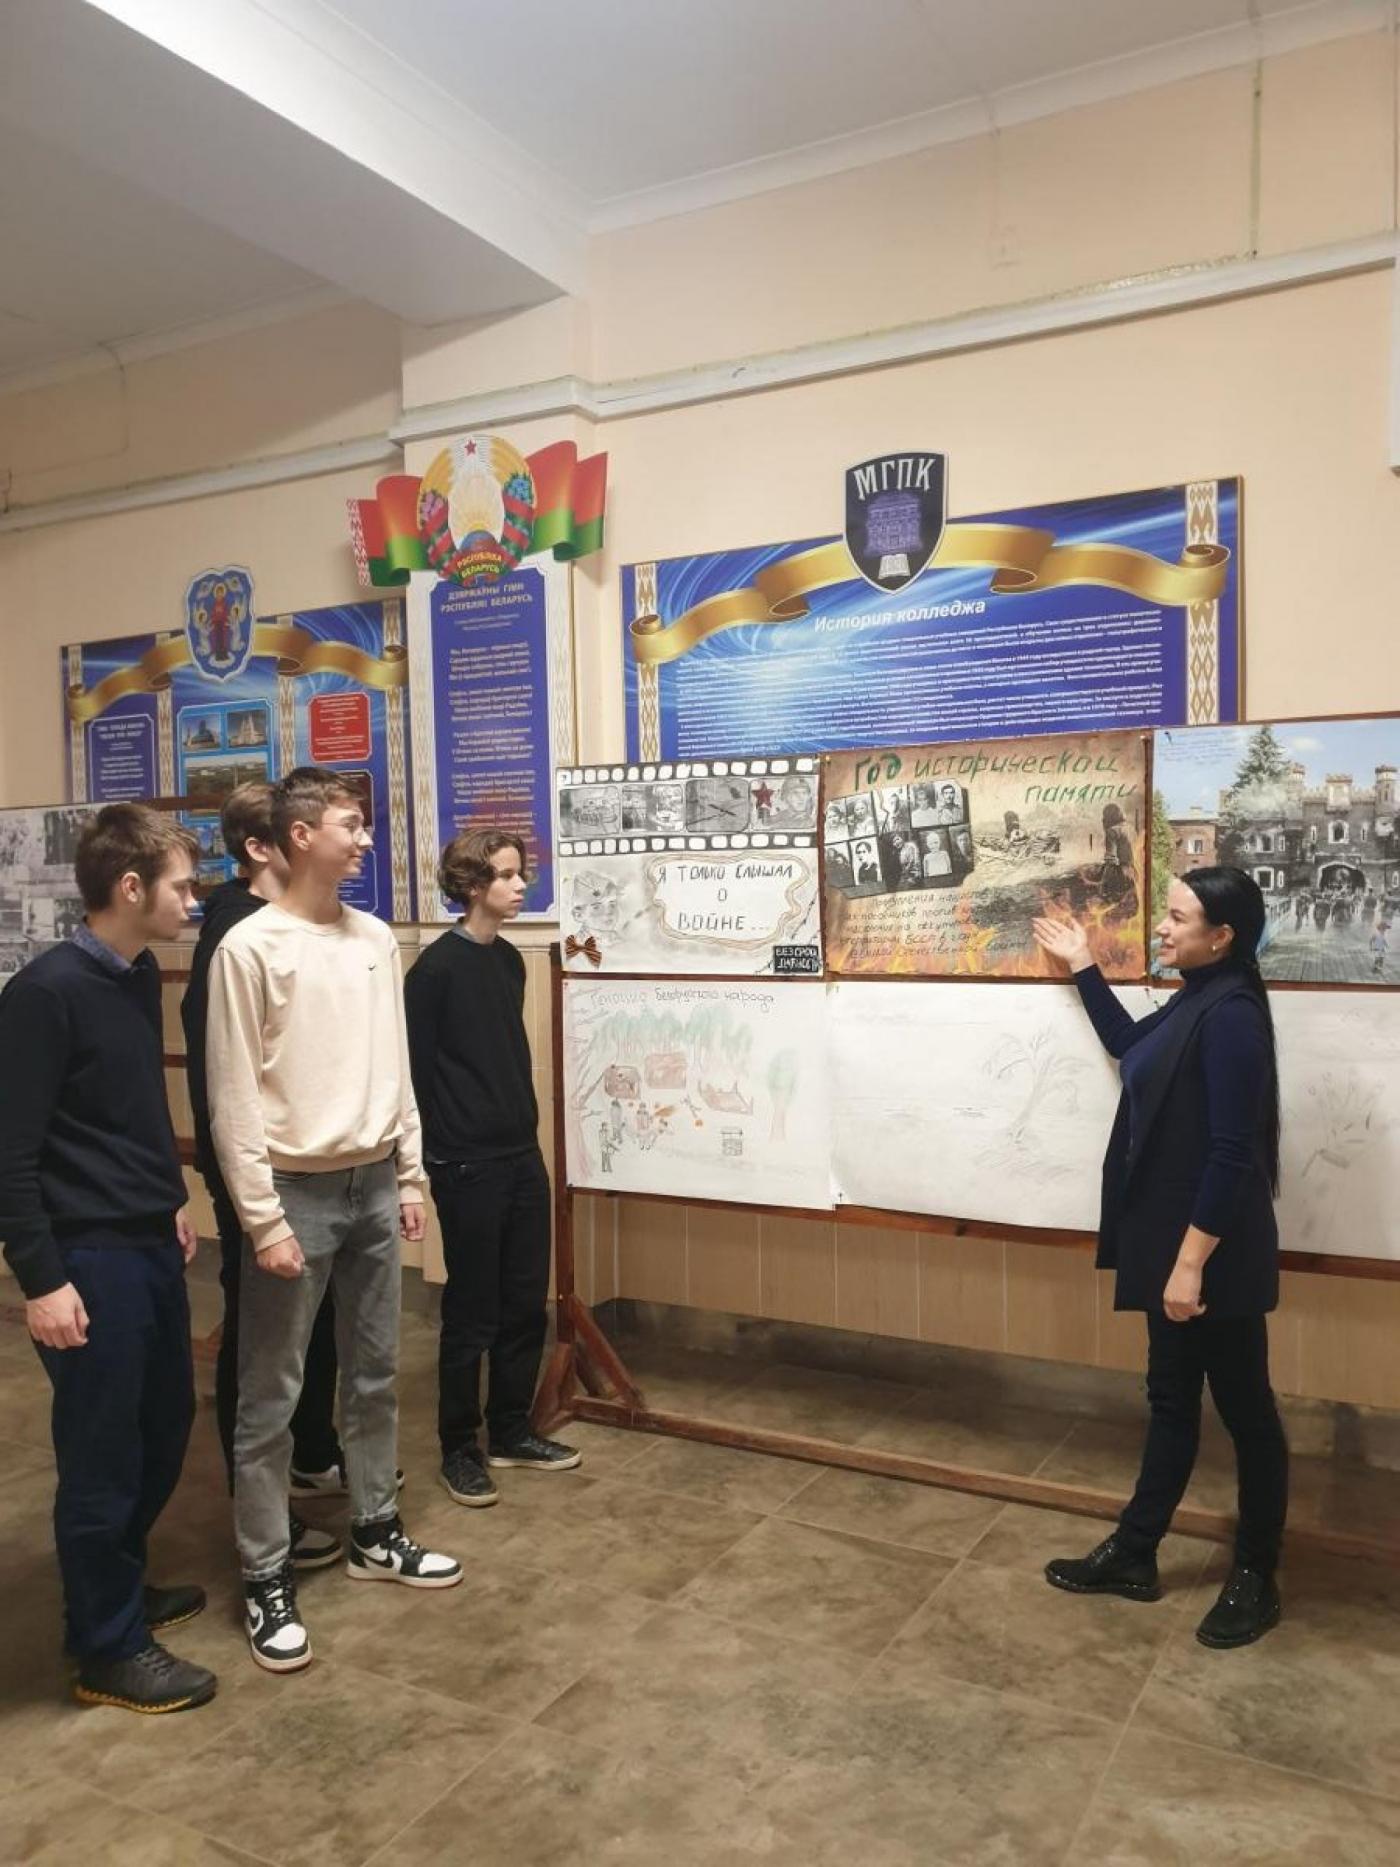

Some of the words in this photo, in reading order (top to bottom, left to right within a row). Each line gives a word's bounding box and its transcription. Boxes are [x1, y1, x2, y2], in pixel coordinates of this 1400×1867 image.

[854, 458, 936, 500] МГПК
[814, 614, 893, 632] История
[896, 600, 986, 623] колледжа
[658, 866, 667, 883] Я
[717, 887, 728, 902] О
